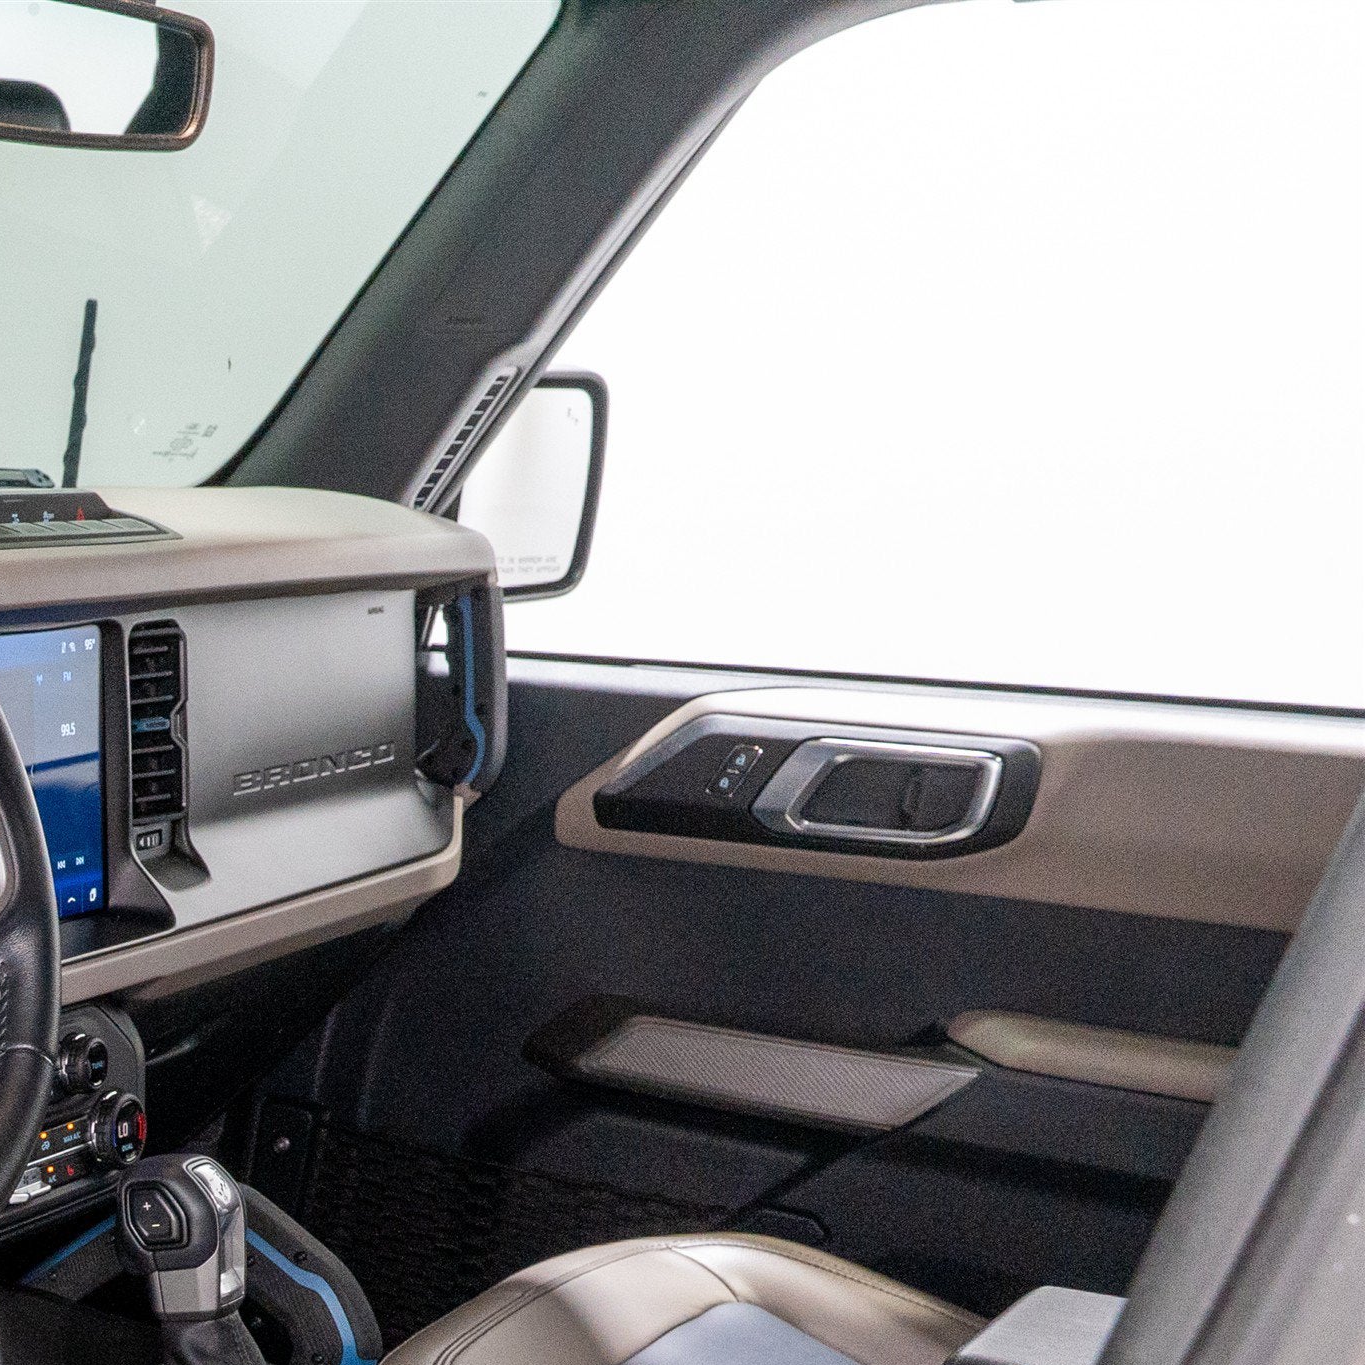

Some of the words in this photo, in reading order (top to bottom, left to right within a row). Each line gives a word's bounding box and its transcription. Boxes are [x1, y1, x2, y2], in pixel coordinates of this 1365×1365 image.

[60, 722, 76, 737] 99.5
[233, 741, 396, 796] BRONCO
[118, 1122, 128, 1138] LO
